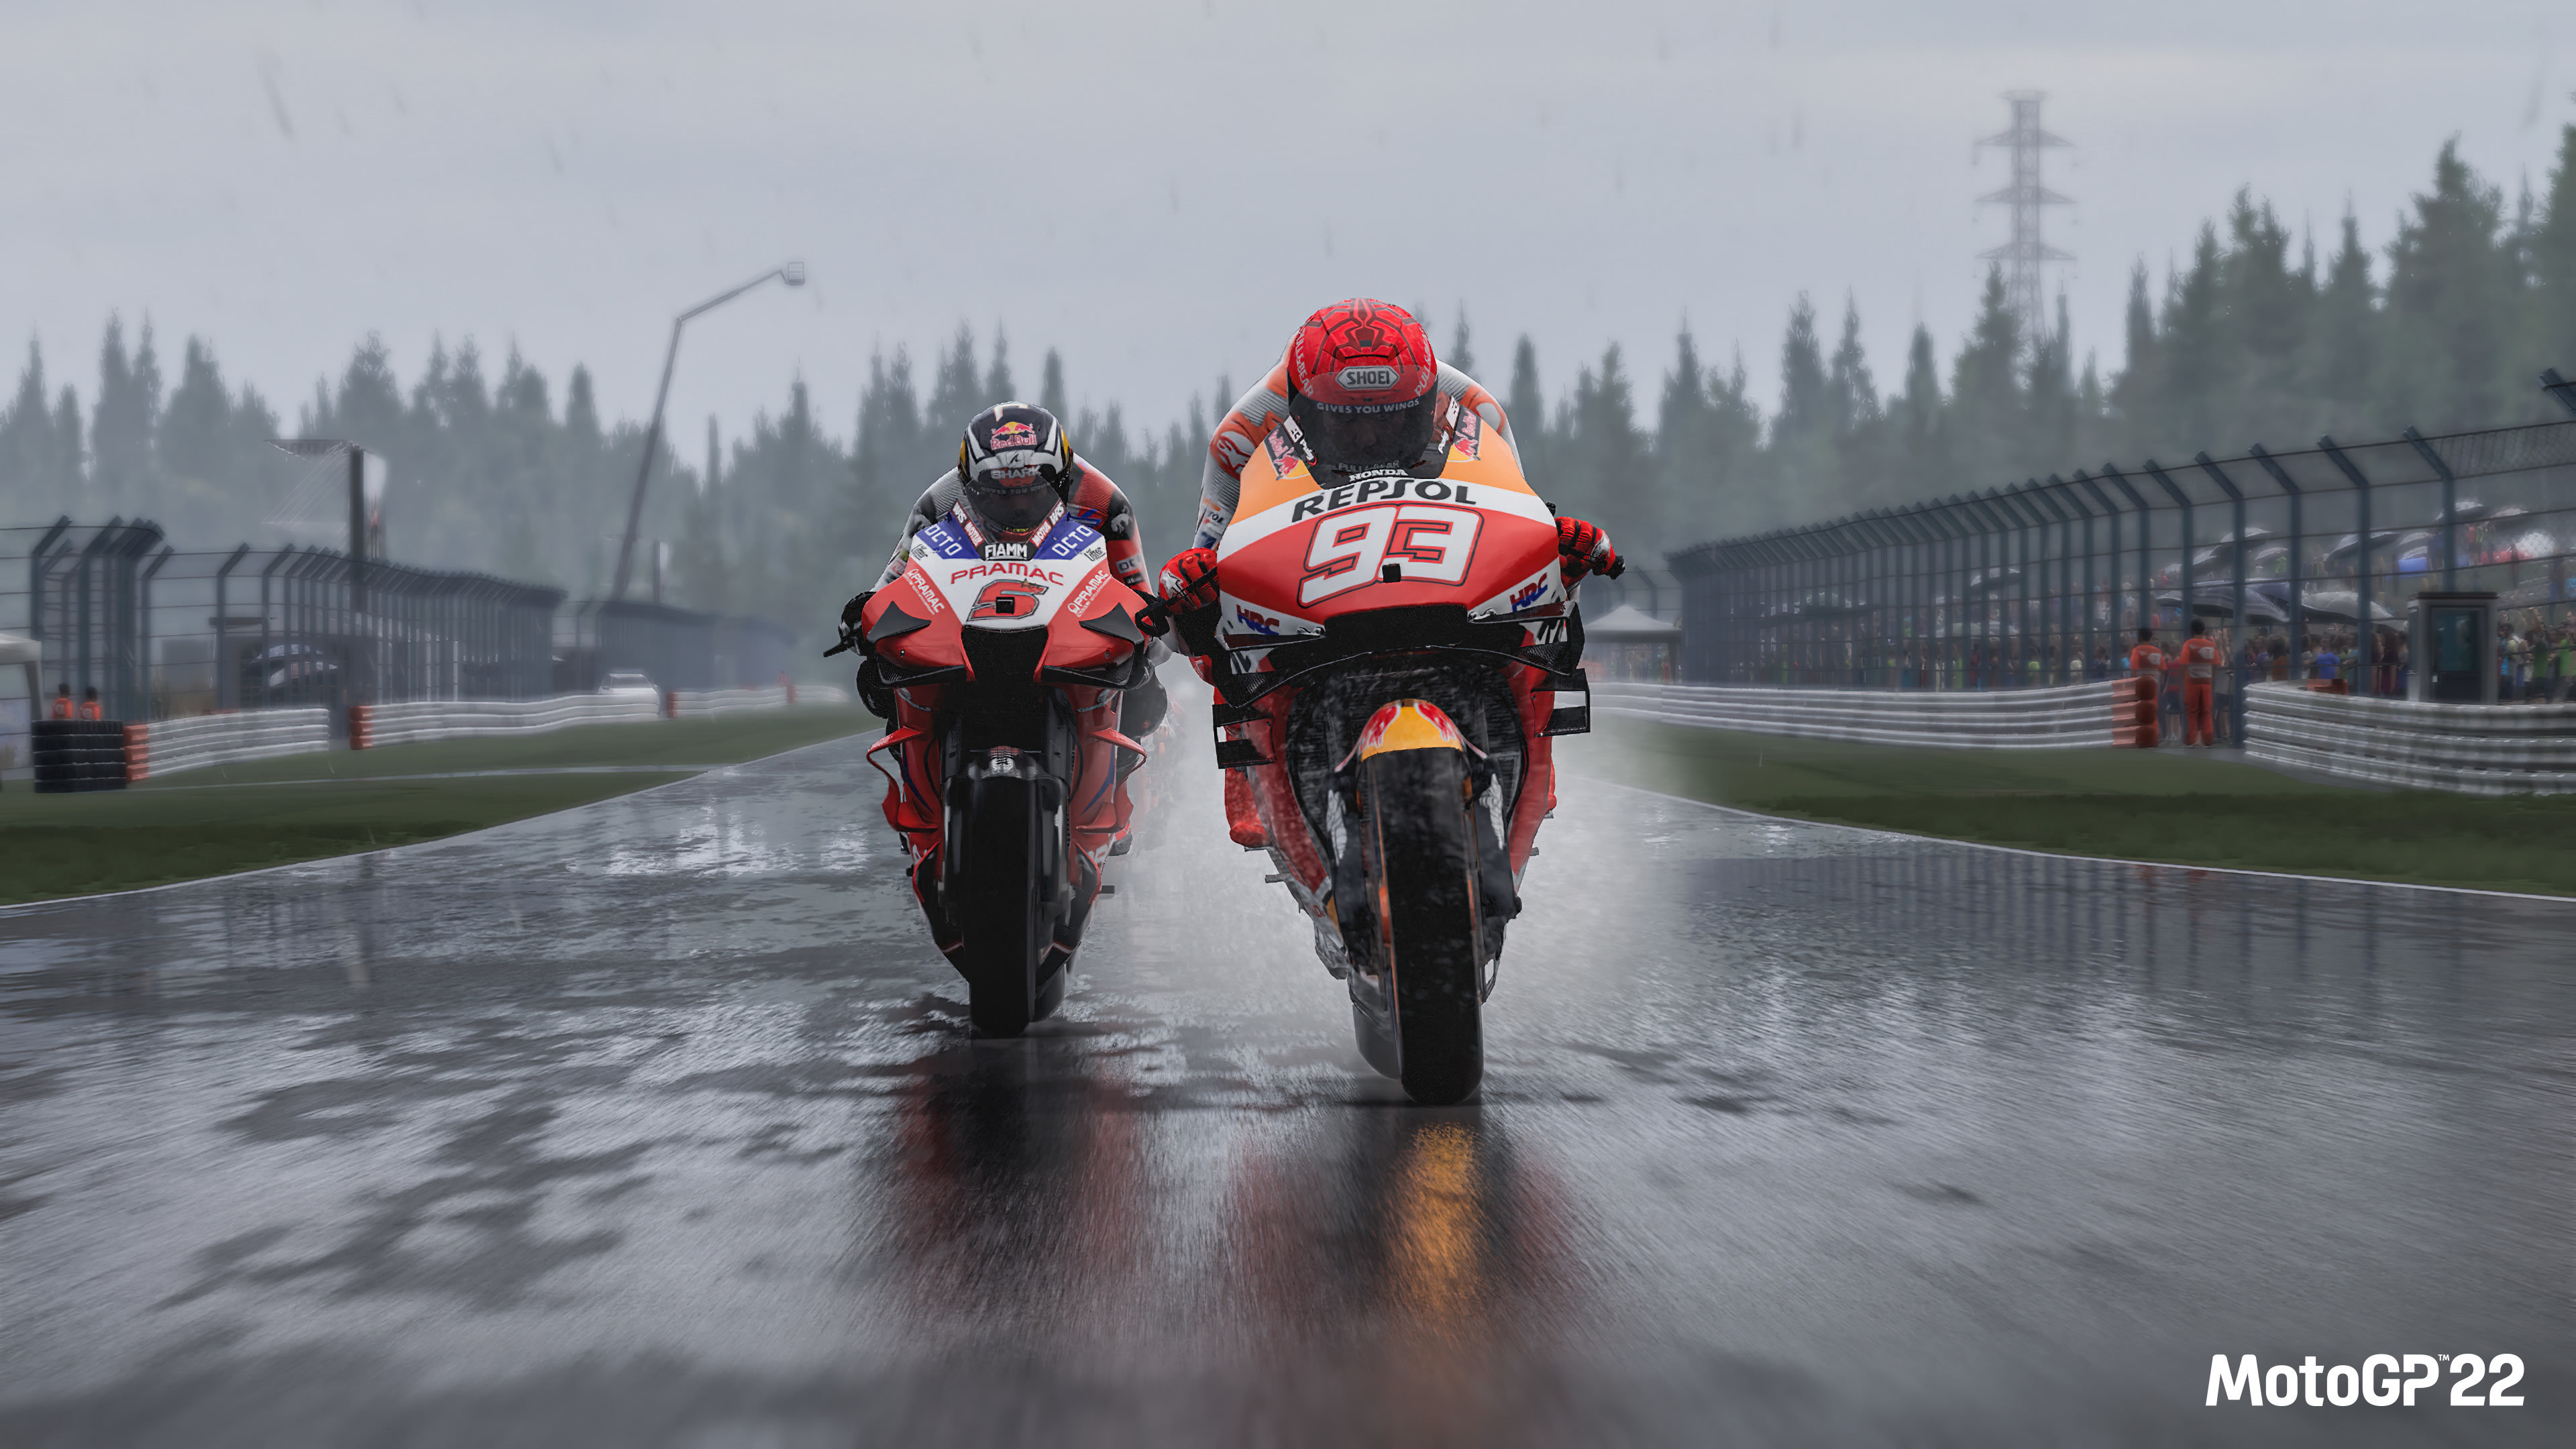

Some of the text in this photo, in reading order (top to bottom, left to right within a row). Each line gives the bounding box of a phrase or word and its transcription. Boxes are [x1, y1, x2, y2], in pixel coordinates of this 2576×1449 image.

[1346, 371, 1390, 385] SHOEI
[1317, 398, 1419, 414] GIVES YOU WINGS
[1014, 435, 1037, 445] Bull
[991, 465, 1040, 480] SHARK
[1349, 469, 1409, 482] HONDA
[1291, 479, 1477, 523] REPSOL
[924, 524, 963, 556] OCTO
[985, 543, 1028, 557] FIAMM
[1052, 525, 1093, 557] OCTO
[1297, 502, 1484, 608] 93
[951, 562, 1064, 586] PRAMAC
[1509, 572, 1548, 612] HRC
